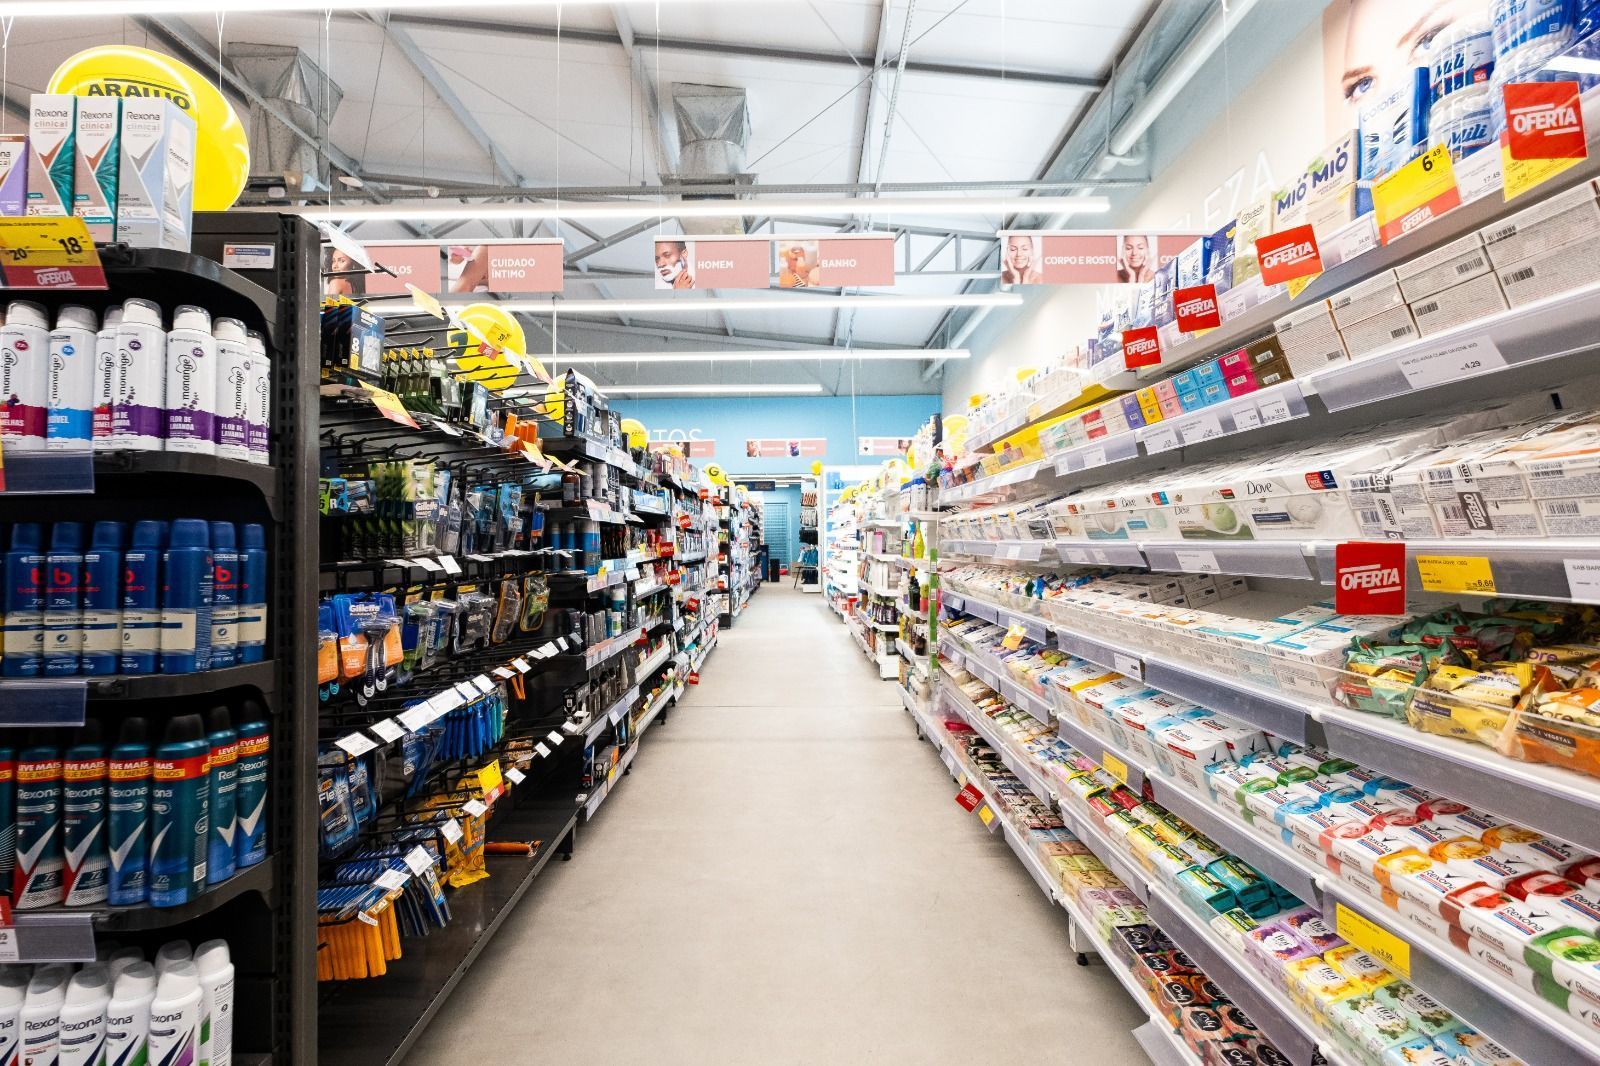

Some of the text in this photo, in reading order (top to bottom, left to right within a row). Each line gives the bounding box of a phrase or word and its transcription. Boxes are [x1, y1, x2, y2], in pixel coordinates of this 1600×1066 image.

[1434, 53, 1465, 82] Mili
[34, 109, 68, 118] Rexona
[80, 111, 112, 120] Rexona
[126, 111, 160, 121] Rexona
[1513, 107, 1578, 133] OFERTA
[34, 119, 68, 128] clinical
[80, 121, 112, 130] clinical
[126, 123, 160, 131] clinical
[1447, 124, 1487, 148] Mili
[1402, 206, 1432, 232] OFERTA
[10, 247, 28, 261] 20
[58, 236, 83, 255] 18
[491, 258, 536, 268] CUIDADO
[821, 258, 857, 268] BANHO
[1045, 256, 1117, 265] CORPO E ROSTO
[1263, 241, 1314, 269] OFERTA
[491, 267, 526, 279] ÍNTIMO
[697, 260, 734, 270] HOMEM
[37, 271, 74, 286] OFERTA
[1178, 299, 1215, 318] OFERTA
[1126, 339, 1157, 356] OFERTA
[103, 356, 115, 398] monange
[119, 352, 130, 395] monange
[182, 358, 194, 400] monange
[235, 370, 244, 410] monange
[1246, 480, 1273, 495] Dove
[1464, 494, 1487, 528] OFERTA
[1340, 567, 1400, 591] OFERTA
[1467, 811, 1498, 827] Rexona
[1367, 835, 1392, 853] Rexona
[1484, 855, 1518, 875] Rexona
[1505, 906, 1545, 932] Rexona
[152, 1011, 184, 1024] exona
